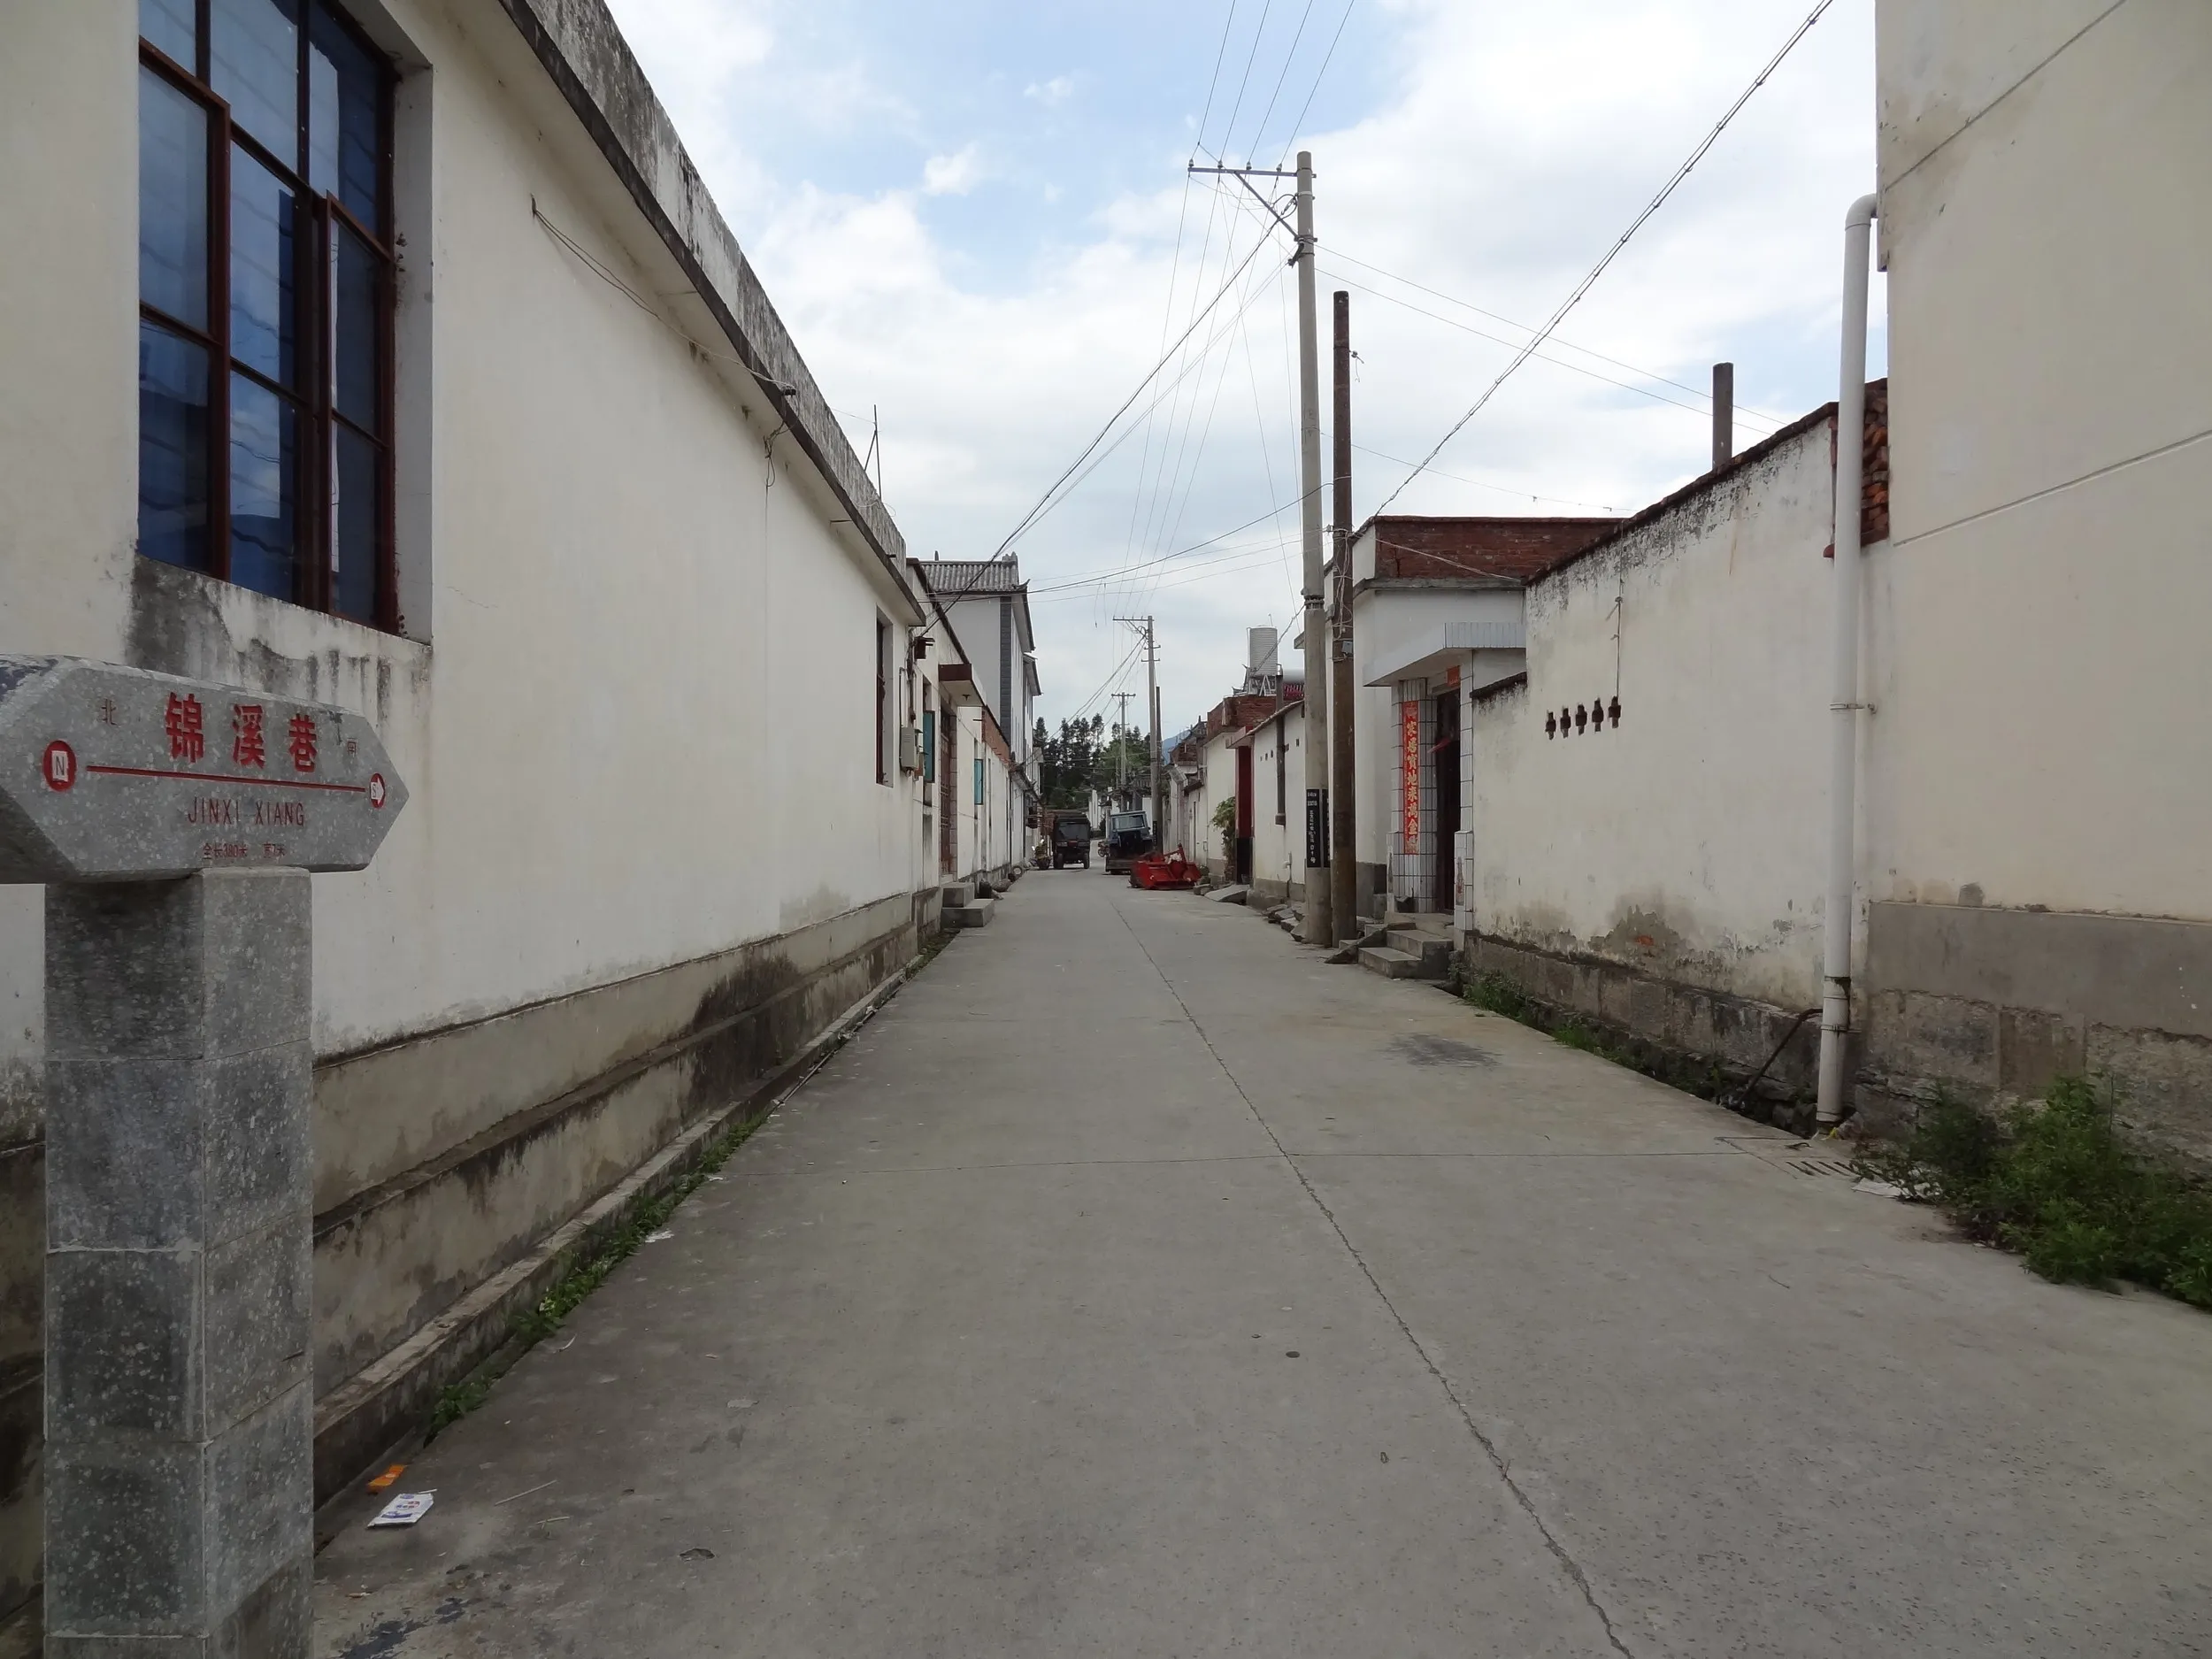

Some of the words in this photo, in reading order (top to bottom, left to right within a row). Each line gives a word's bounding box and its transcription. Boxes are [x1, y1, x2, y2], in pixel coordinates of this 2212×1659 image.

[101, 698, 118, 726] 北
[164, 692, 318, 772] 锦溪巷
[347, 737, 357, 757] 南
[54, 755, 65, 777] N
[188, 796, 240, 825] JINXI
[254, 800, 305, 826] XIANG
